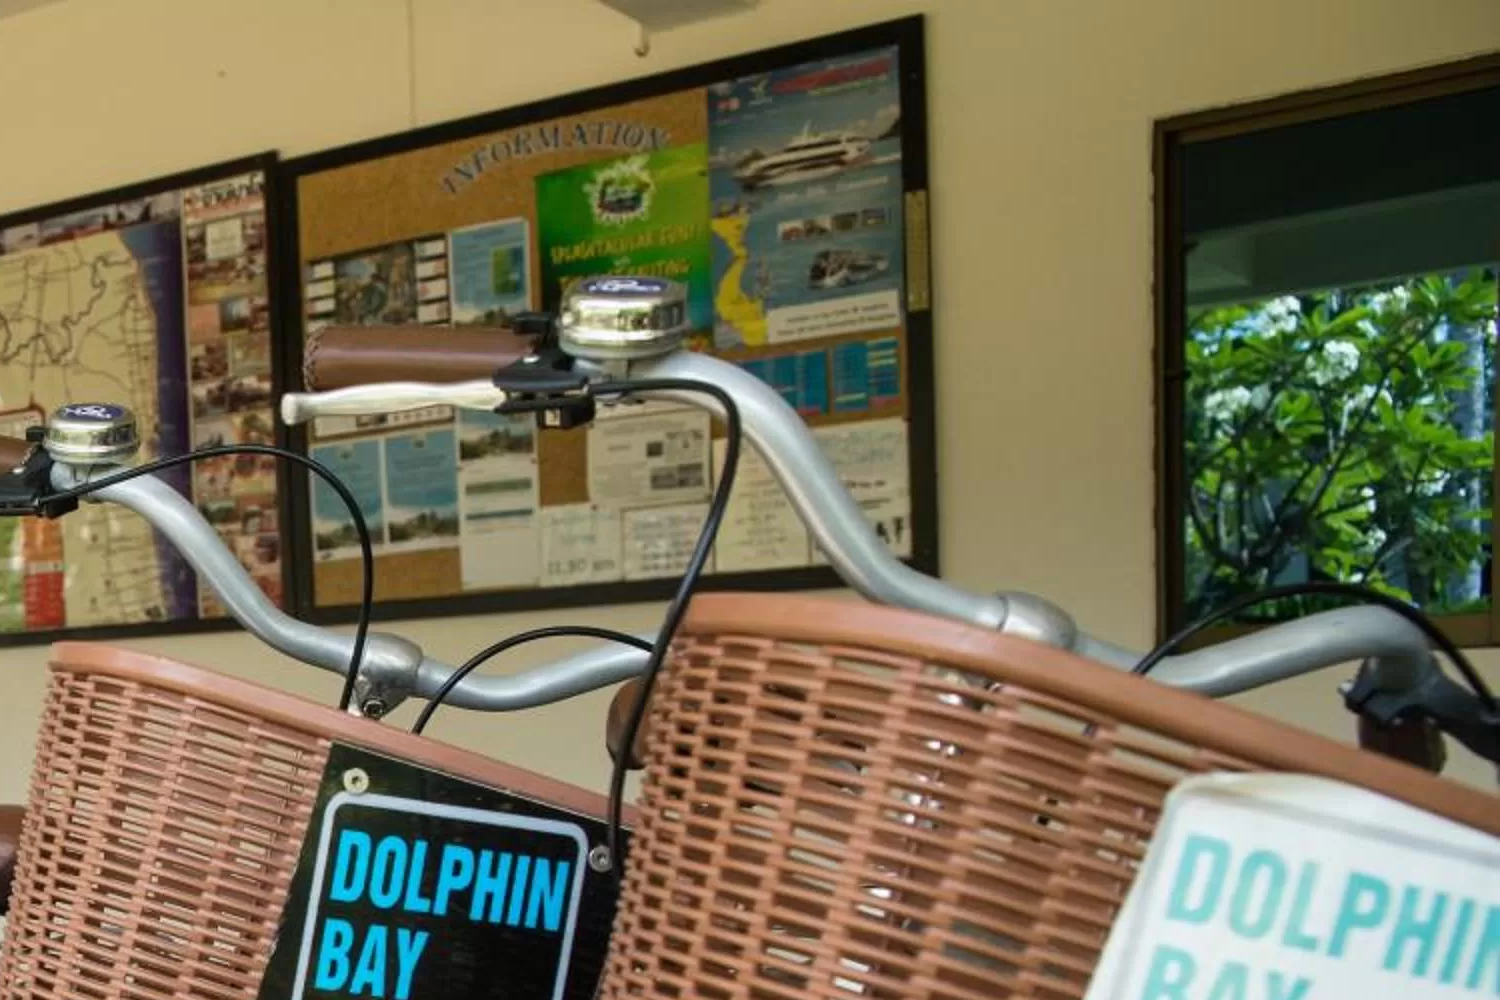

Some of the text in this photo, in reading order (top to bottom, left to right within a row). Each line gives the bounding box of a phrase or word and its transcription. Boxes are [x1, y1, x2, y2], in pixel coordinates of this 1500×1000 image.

[441, 122, 671, 195] INFORMATION
[330, 830, 570, 932] DOLPHIN
[1166, 834, 1500, 998] DOLPHIN
[316, 918, 430, 1000] BAY
